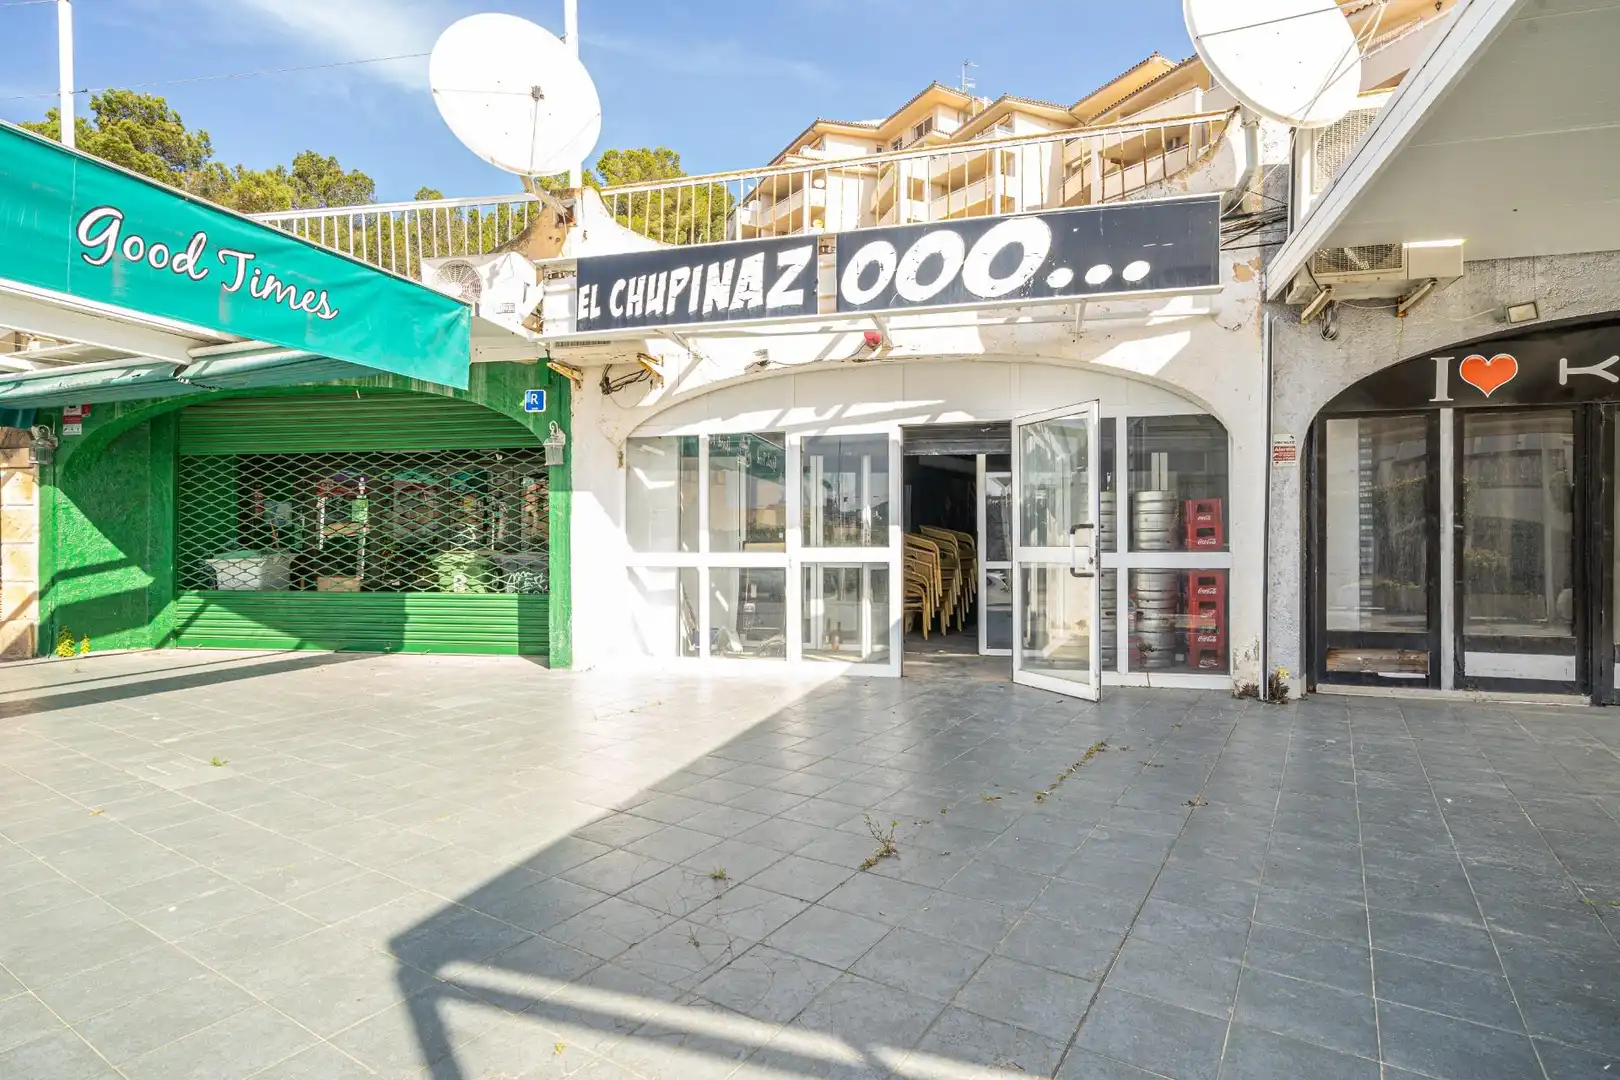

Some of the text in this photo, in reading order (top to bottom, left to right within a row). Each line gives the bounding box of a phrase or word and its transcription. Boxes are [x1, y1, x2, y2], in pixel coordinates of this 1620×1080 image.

[76, 205, 339, 320] Good Times
[577, 284, 601, 320] EL
[530, 394, 538, 404] R
[1429, 356, 1455, 402] I
